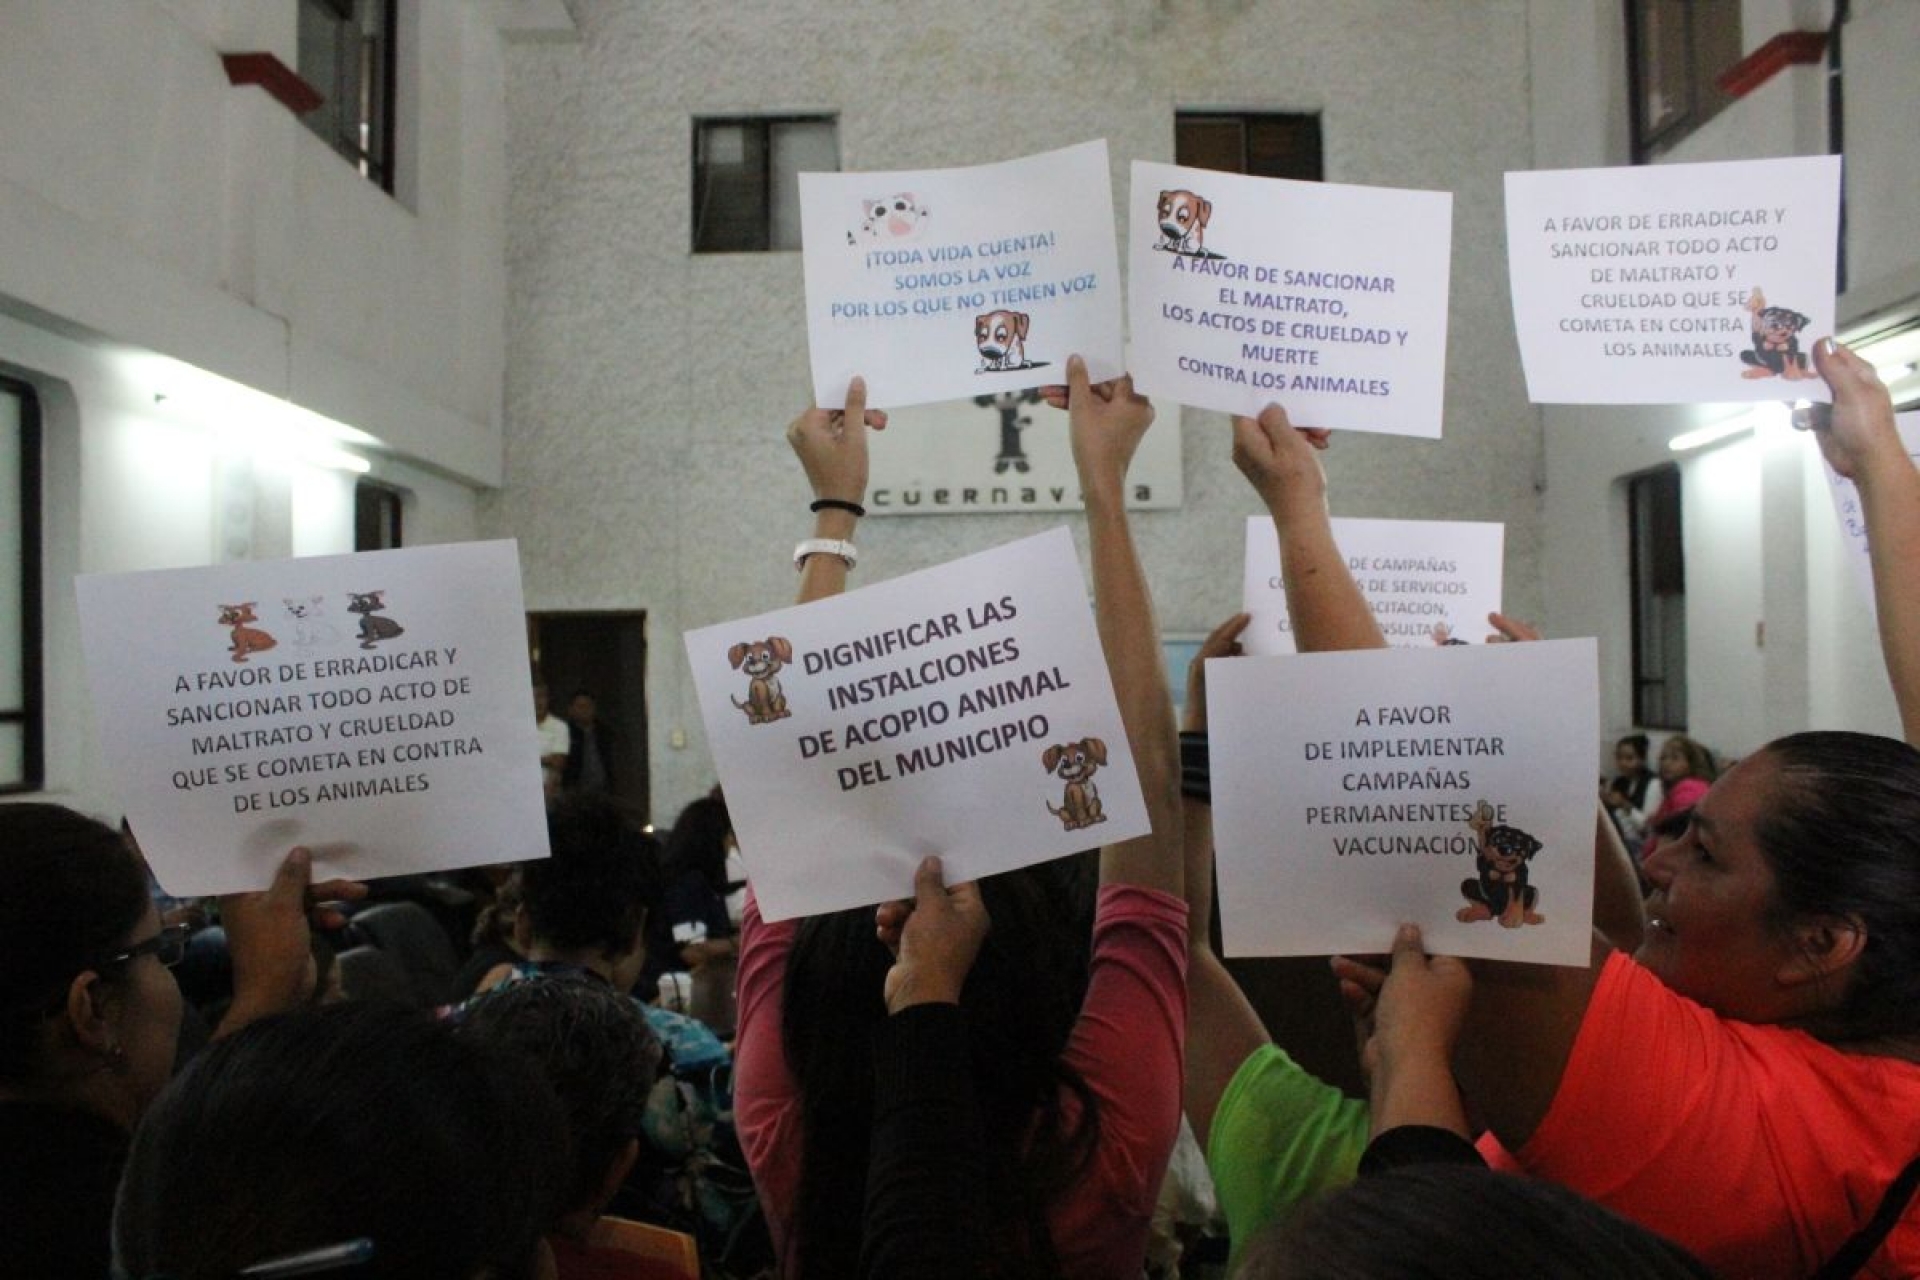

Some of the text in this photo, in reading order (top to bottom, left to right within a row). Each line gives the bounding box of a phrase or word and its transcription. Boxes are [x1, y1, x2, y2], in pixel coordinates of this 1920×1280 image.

[1544, 209, 1786, 232] A FAVOR DE ERRADICAR Y
[866, 231, 1055, 268] ¡TODA VIDA CUENTA!
[1551, 236, 1778, 258] SANCIONAR TODO ACTO
[895, 261, 1031, 291] SOMOS LA VOZ
[1173, 256, 1395, 293] A FAVOR DE SANCIONAR
[1591, 265, 1736, 283] DE MALTRATO Y
[831, 274, 1097, 318] POR LOS QUE NO TIENEN VOZ
[1218, 288, 1349, 319] EL MALTRATO,
[1580, 291, 1748, 310] CRUELDAD QUE SE
[1162, 304, 1408, 346] LOS ACTOS DE CRUELDAD Y
[1559, 317, 1743, 333] COMETA EN CONTRA
[1241, 344, 1319, 365] MUERTE
[1604, 343, 1734, 357] LOS ANIMALES
[1178, 356, 1390, 396] CONTRA LOS ANIMALES
[1350, 555, 1457, 572] DE CAMPAÑAS
[1369, 580, 1387, 592] DE
[1391, 580, 1467, 595] SERVICIOS
[1368, 601, 1449, 617] CITACION,
[803, 597, 1017, 675] DIGNIFICAR LAS
[175, 648, 457, 693] A FAVOR DE ERRADICAR Y
[828, 638, 1020, 711] INSTALCIONES
[166, 677, 471, 727] SANCIONAR TODO ACTO DE
[798, 666, 1070, 759] DE ACOPIO ANIMAL
[1356, 706, 1450, 726] A FAVOR
[192, 709, 454, 756] MALTRATO Y CRUELDAD
[837, 714, 1050, 791] DEL MUNICIPIO
[1305, 737, 1504, 760] DE IMPLEMENTAR
[173, 737, 483, 792] QUE SE COMETA EN CONTRA
[1342, 767, 1470, 791] CAMPAÑAS
[234, 774, 429, 813] DE LOS ANIMALES
[1306, 804, 1507, 824] PERMANENTES DE
[1333, 832, 1481, 856] VACUNACIÓN
